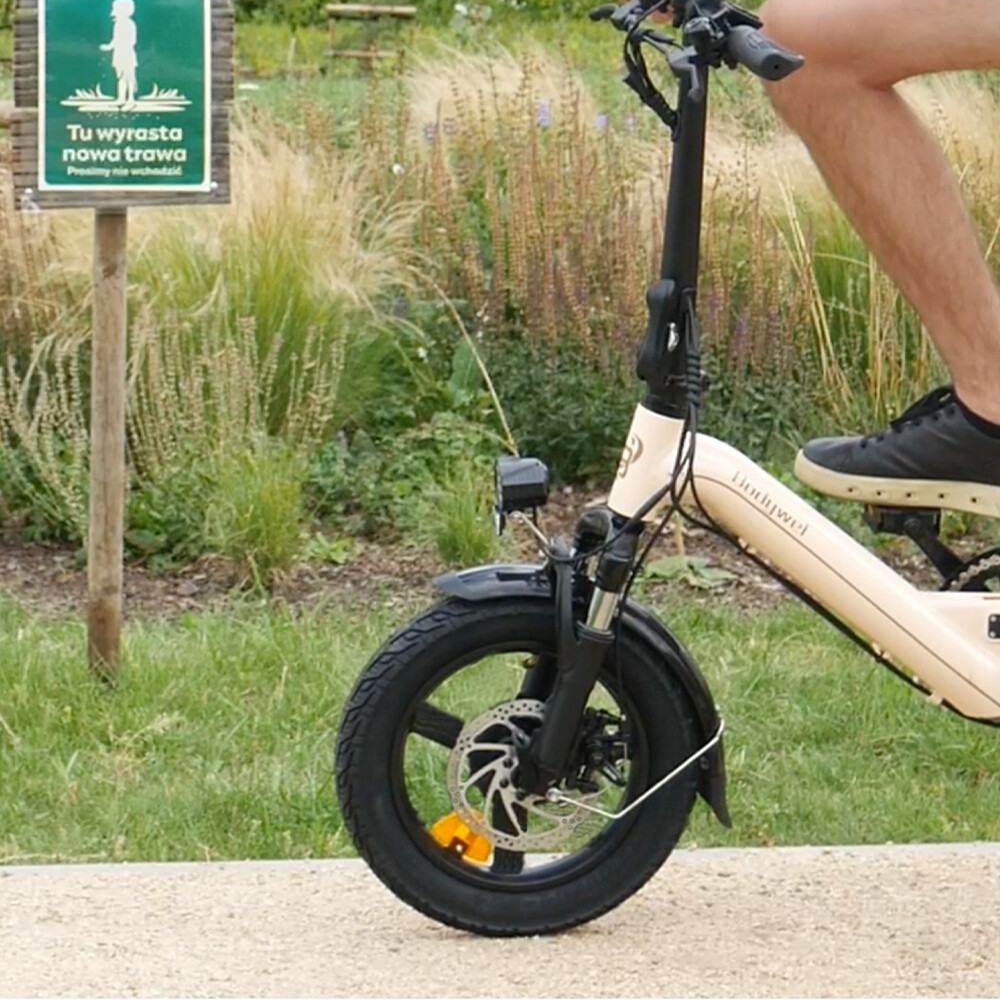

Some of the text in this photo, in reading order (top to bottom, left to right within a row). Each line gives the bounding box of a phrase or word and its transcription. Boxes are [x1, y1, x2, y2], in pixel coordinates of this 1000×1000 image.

[66, 124, 183, 145] Tu wyrasta
[62, 146, 187, 162] nowa trawa
